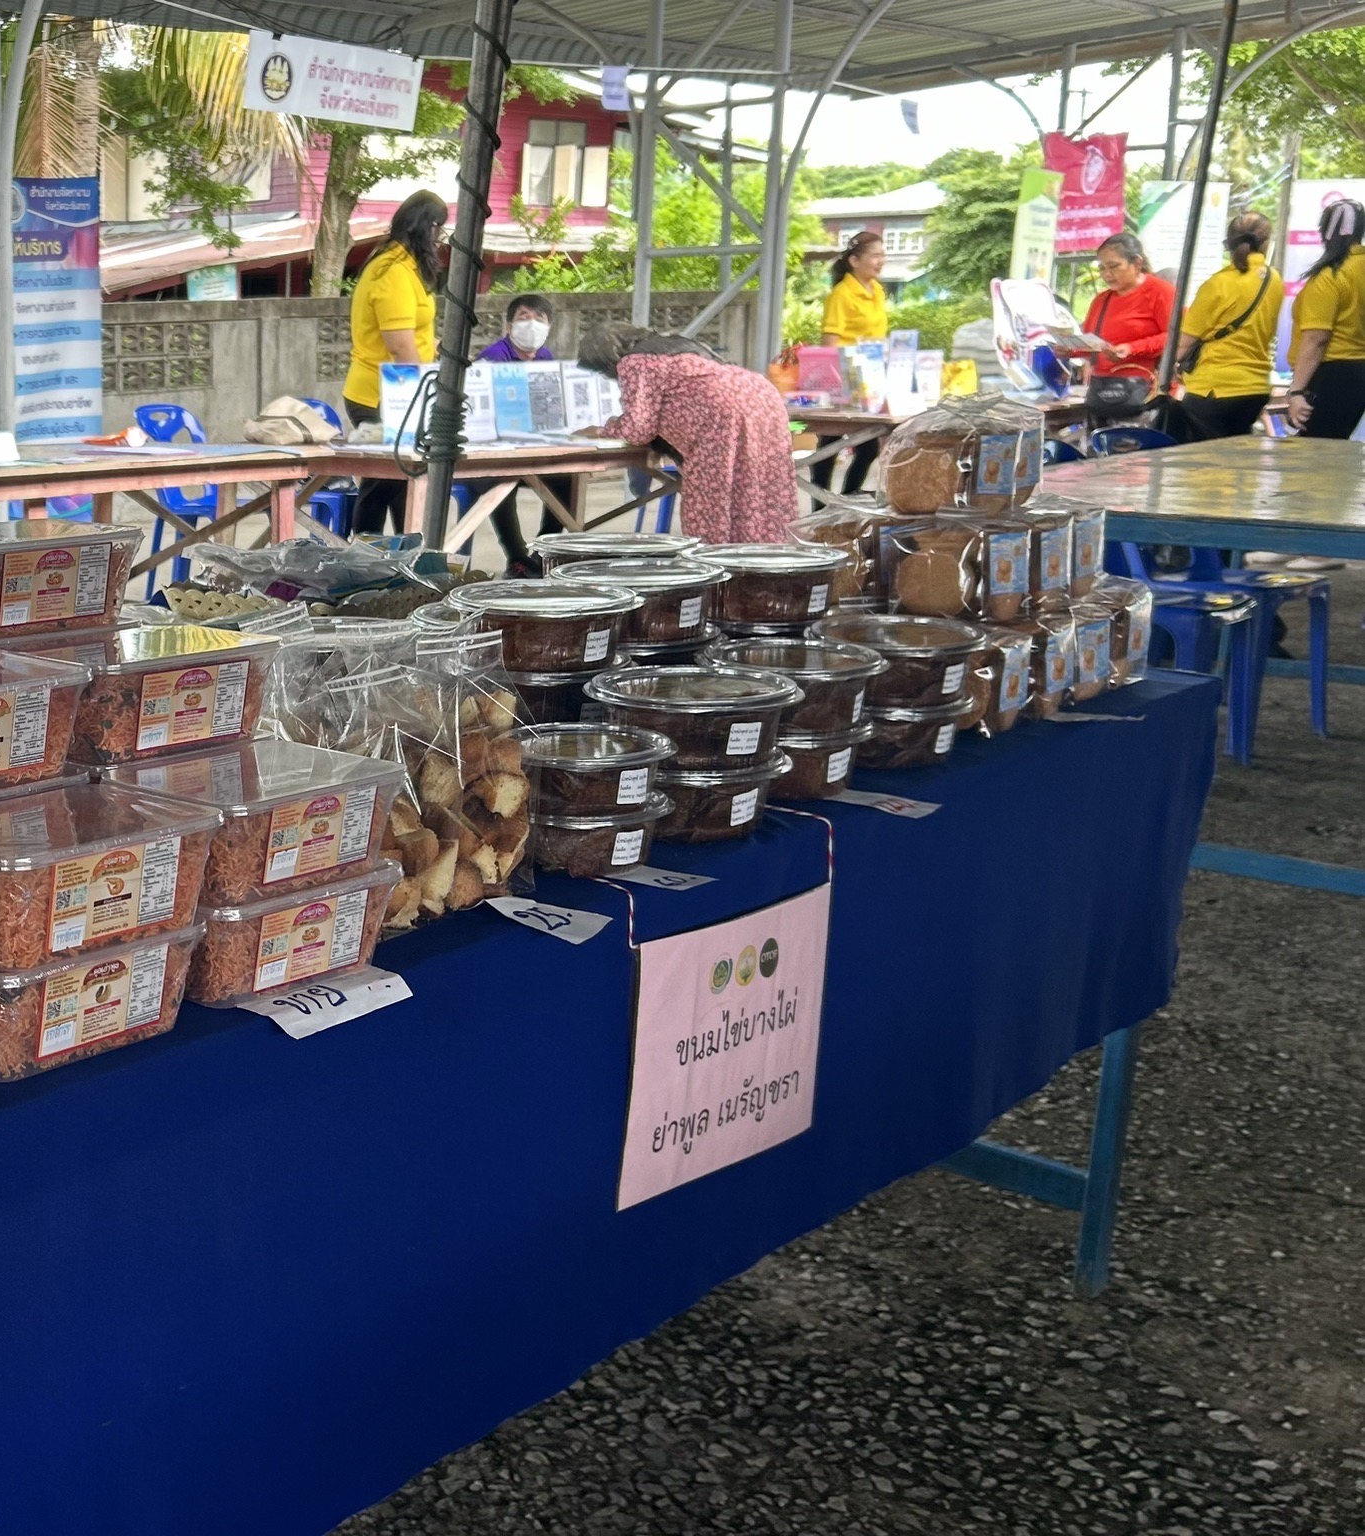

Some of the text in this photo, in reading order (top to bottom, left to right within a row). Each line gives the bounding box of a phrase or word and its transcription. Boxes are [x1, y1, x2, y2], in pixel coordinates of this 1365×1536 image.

[12, 237, 62, 256] ห้บริการ
[676, 986, 798, 1066] ขนมไข่บางไผ่
[652, 1069, 799, 1155] ย่าพูล เนรัญชรา
